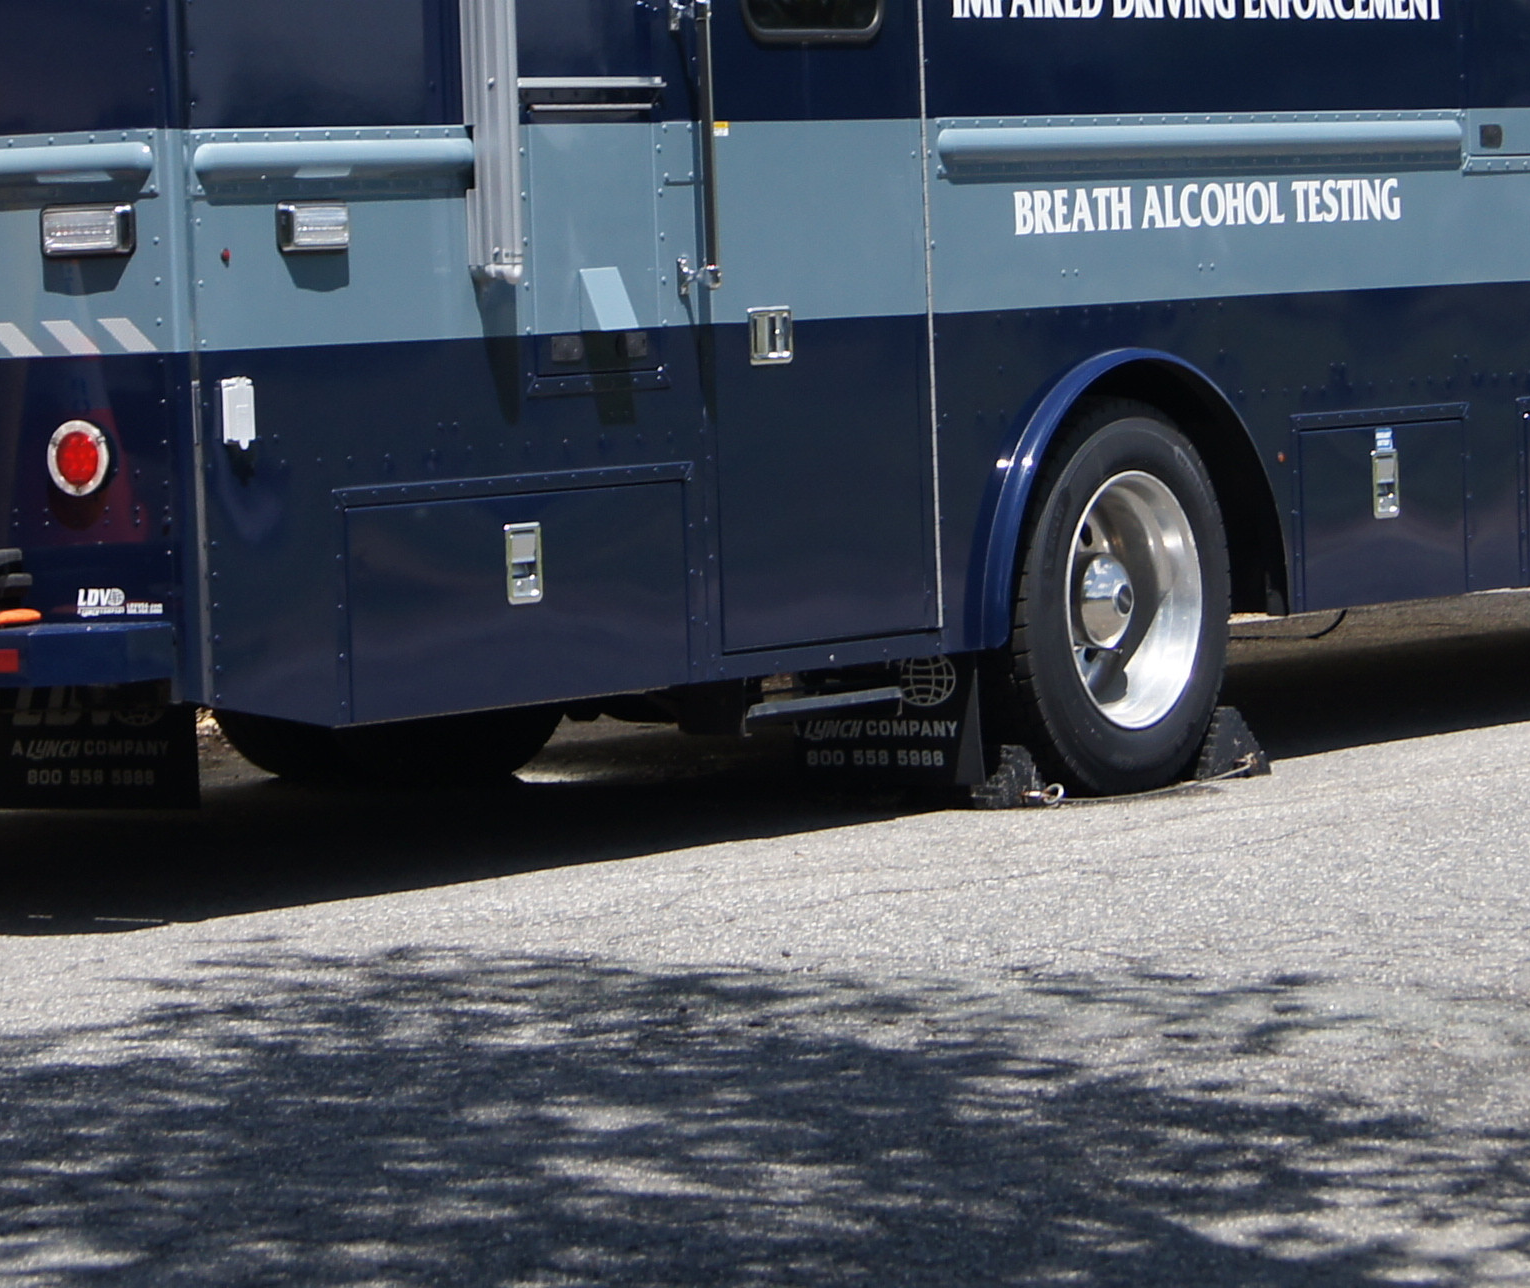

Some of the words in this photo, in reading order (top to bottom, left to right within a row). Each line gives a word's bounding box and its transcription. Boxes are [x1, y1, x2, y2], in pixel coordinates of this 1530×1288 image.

[1013, 186, 1133, 236] BREATH
[1141, 181, 1286, 229] ALCOHOL
[1290, 178, 1401, 223] TESTING
[77, 588, 111, 607] LDV
[804, 720, 863, 741] LYNCH
[865, 719, 959, 738] COMPANY
[11, 741, 23, 756] A
[26, 740, 80, 761] LYNCH
[83, 739, 169, 757] COMPANY
[806, 749, 845, 767] 800
[27, 768, 62, 786] 800
